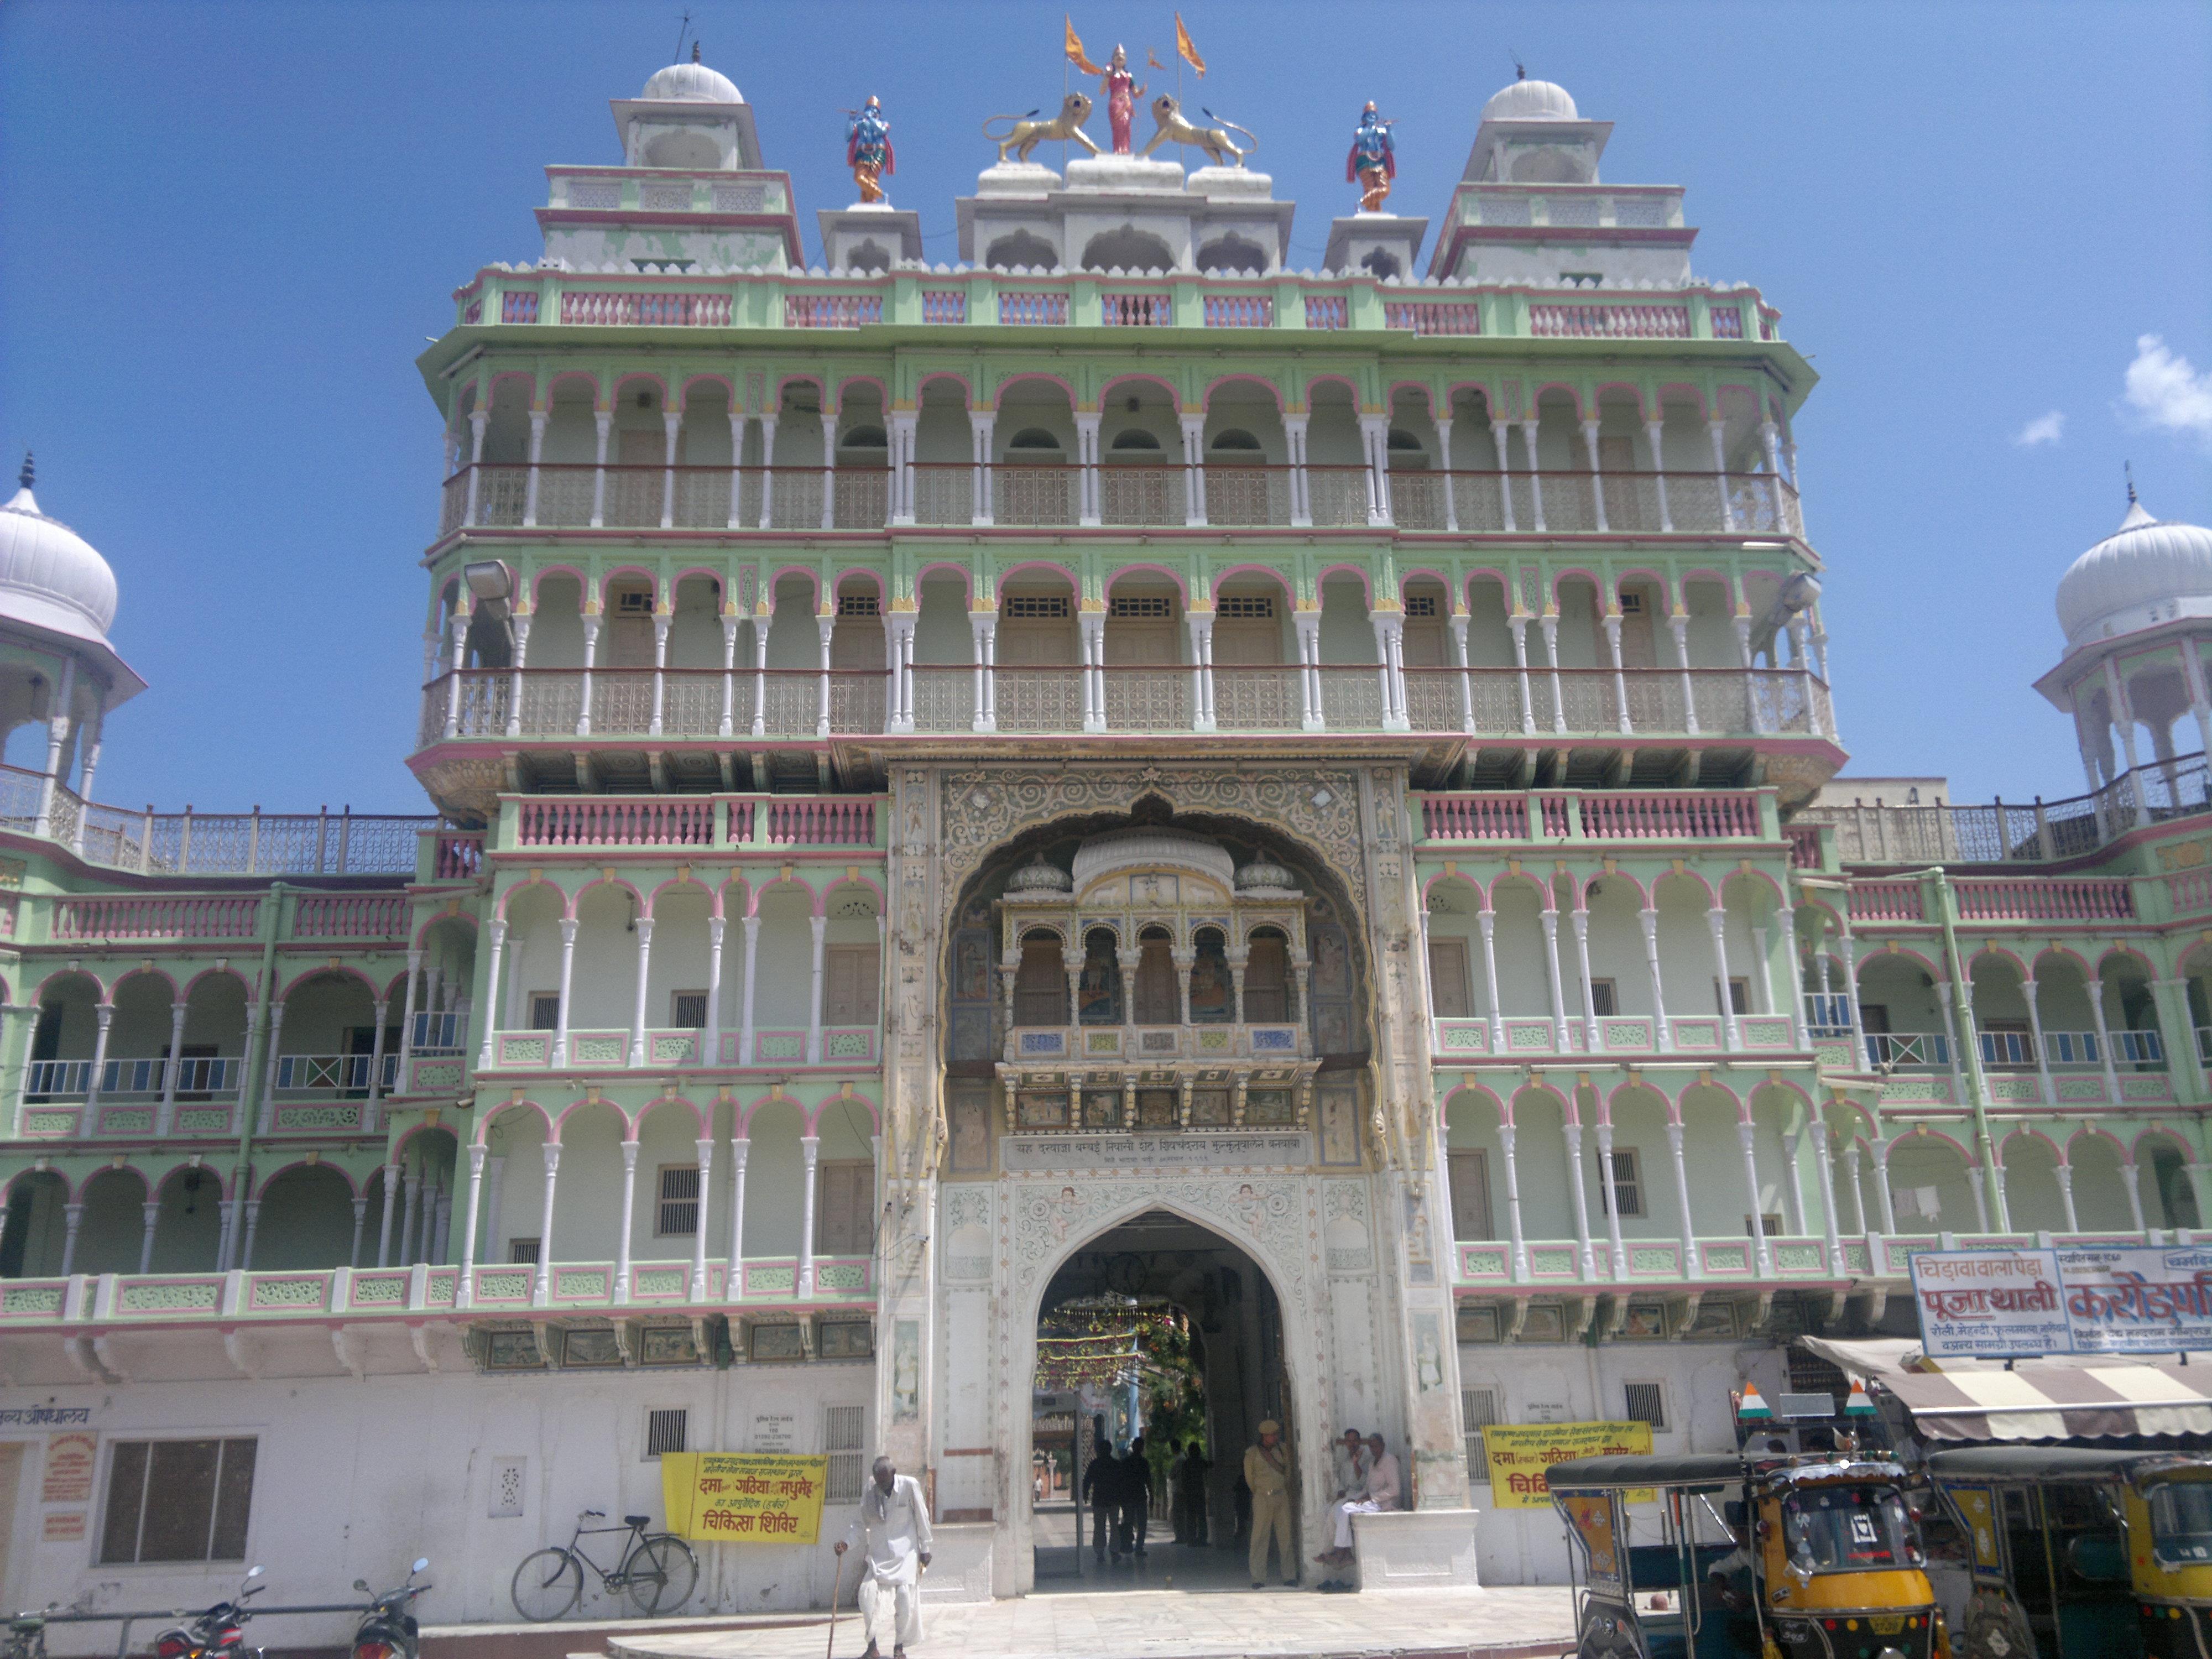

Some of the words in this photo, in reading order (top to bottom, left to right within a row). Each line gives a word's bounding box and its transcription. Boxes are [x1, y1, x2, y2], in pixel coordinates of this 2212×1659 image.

[1016, 1144, 1032, 1155] यह
[1916, 1255, 1975, 1281] चिड़ावा
[1976, 1259, 2013, 1276] वाला
[1919, 1288, 1995, 1322] पूजा
[1990, 1280, 2059, 1312] थाली
[2065, 1270, 2212, 1328] करोड़पि
[1491, 1451, 1516, 1466] दमा
[699, 1478, 723, 1495] दमा
[735, 1475, 771, 1494] गठिया
[779, 1477, 813, 1500] मधुमेह
[1506, 1472, 1548, 1494] चिकि
[703, 1509, 756, 1532] चिकित्सा
[758, 1510, 799, 1533] शिविर
